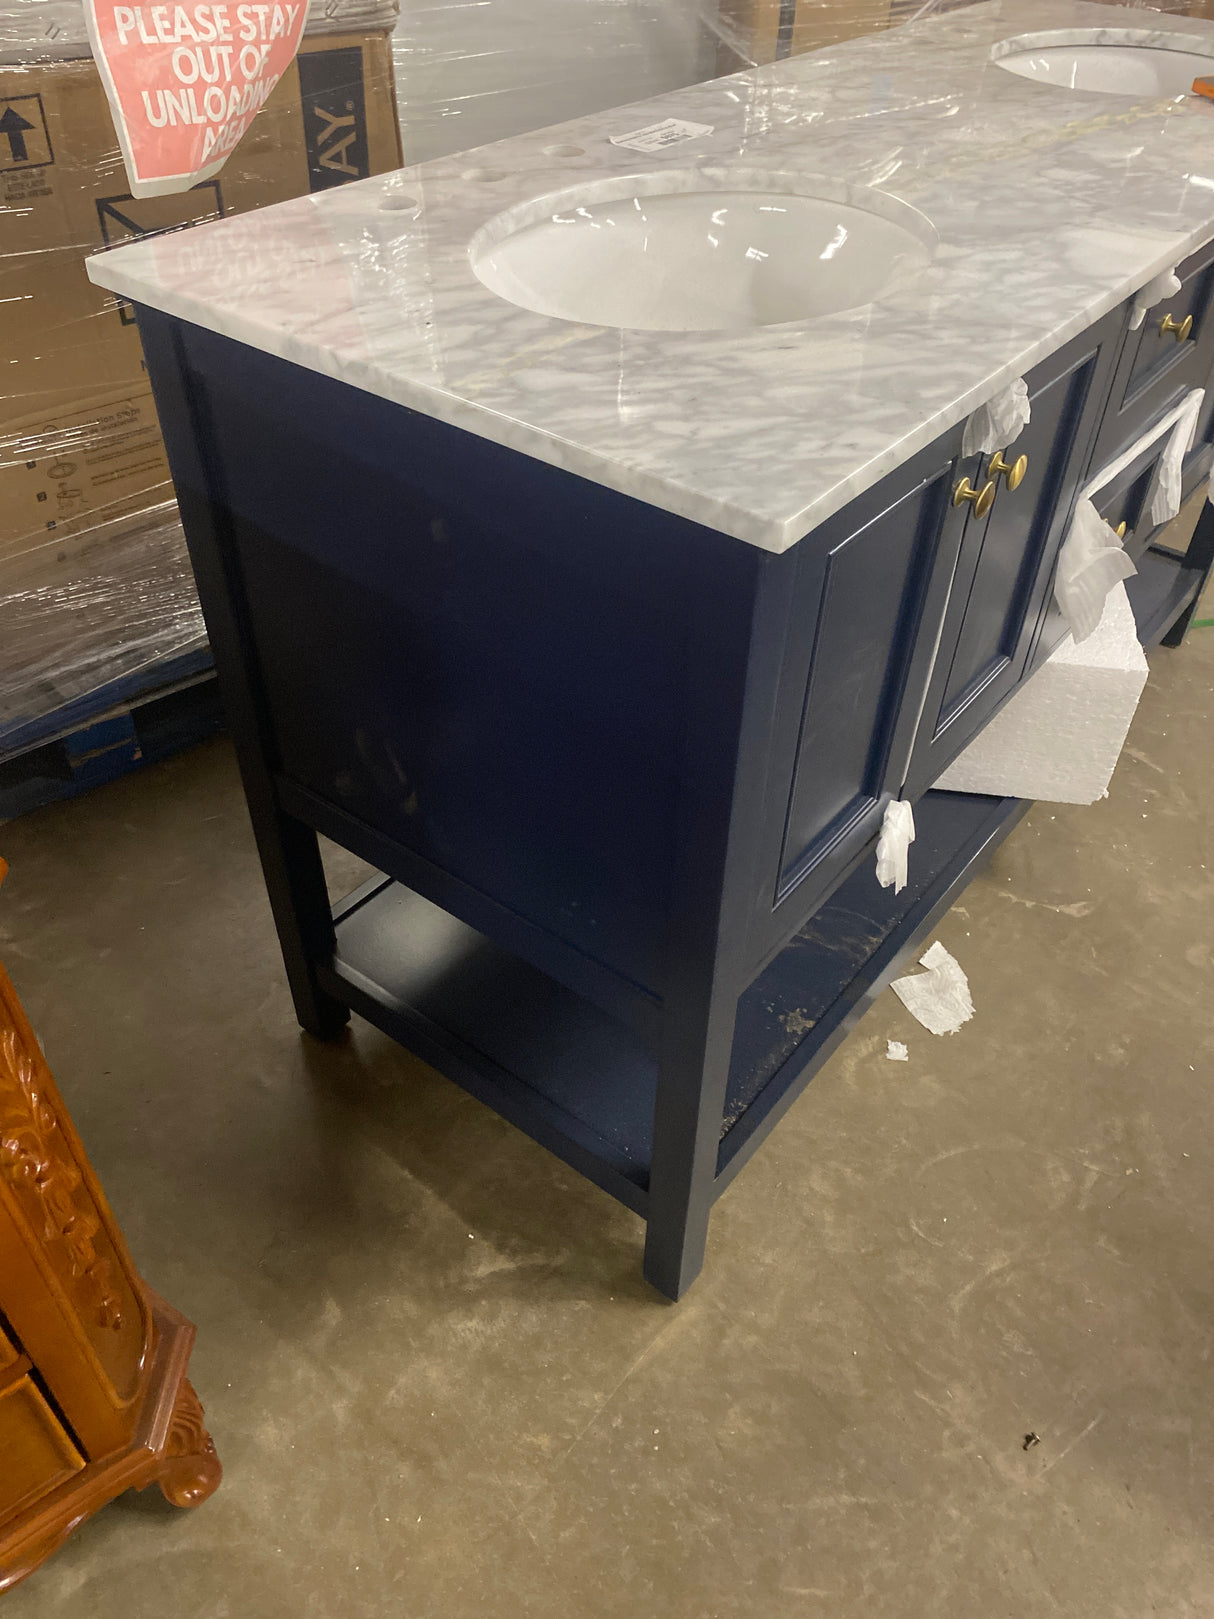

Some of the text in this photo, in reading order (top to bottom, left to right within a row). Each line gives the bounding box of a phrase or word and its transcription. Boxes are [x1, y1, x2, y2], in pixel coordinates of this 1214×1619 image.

[113, 3, 301, 45] PLEASE STAY
[172, 44, 272, 84] OUT OF
